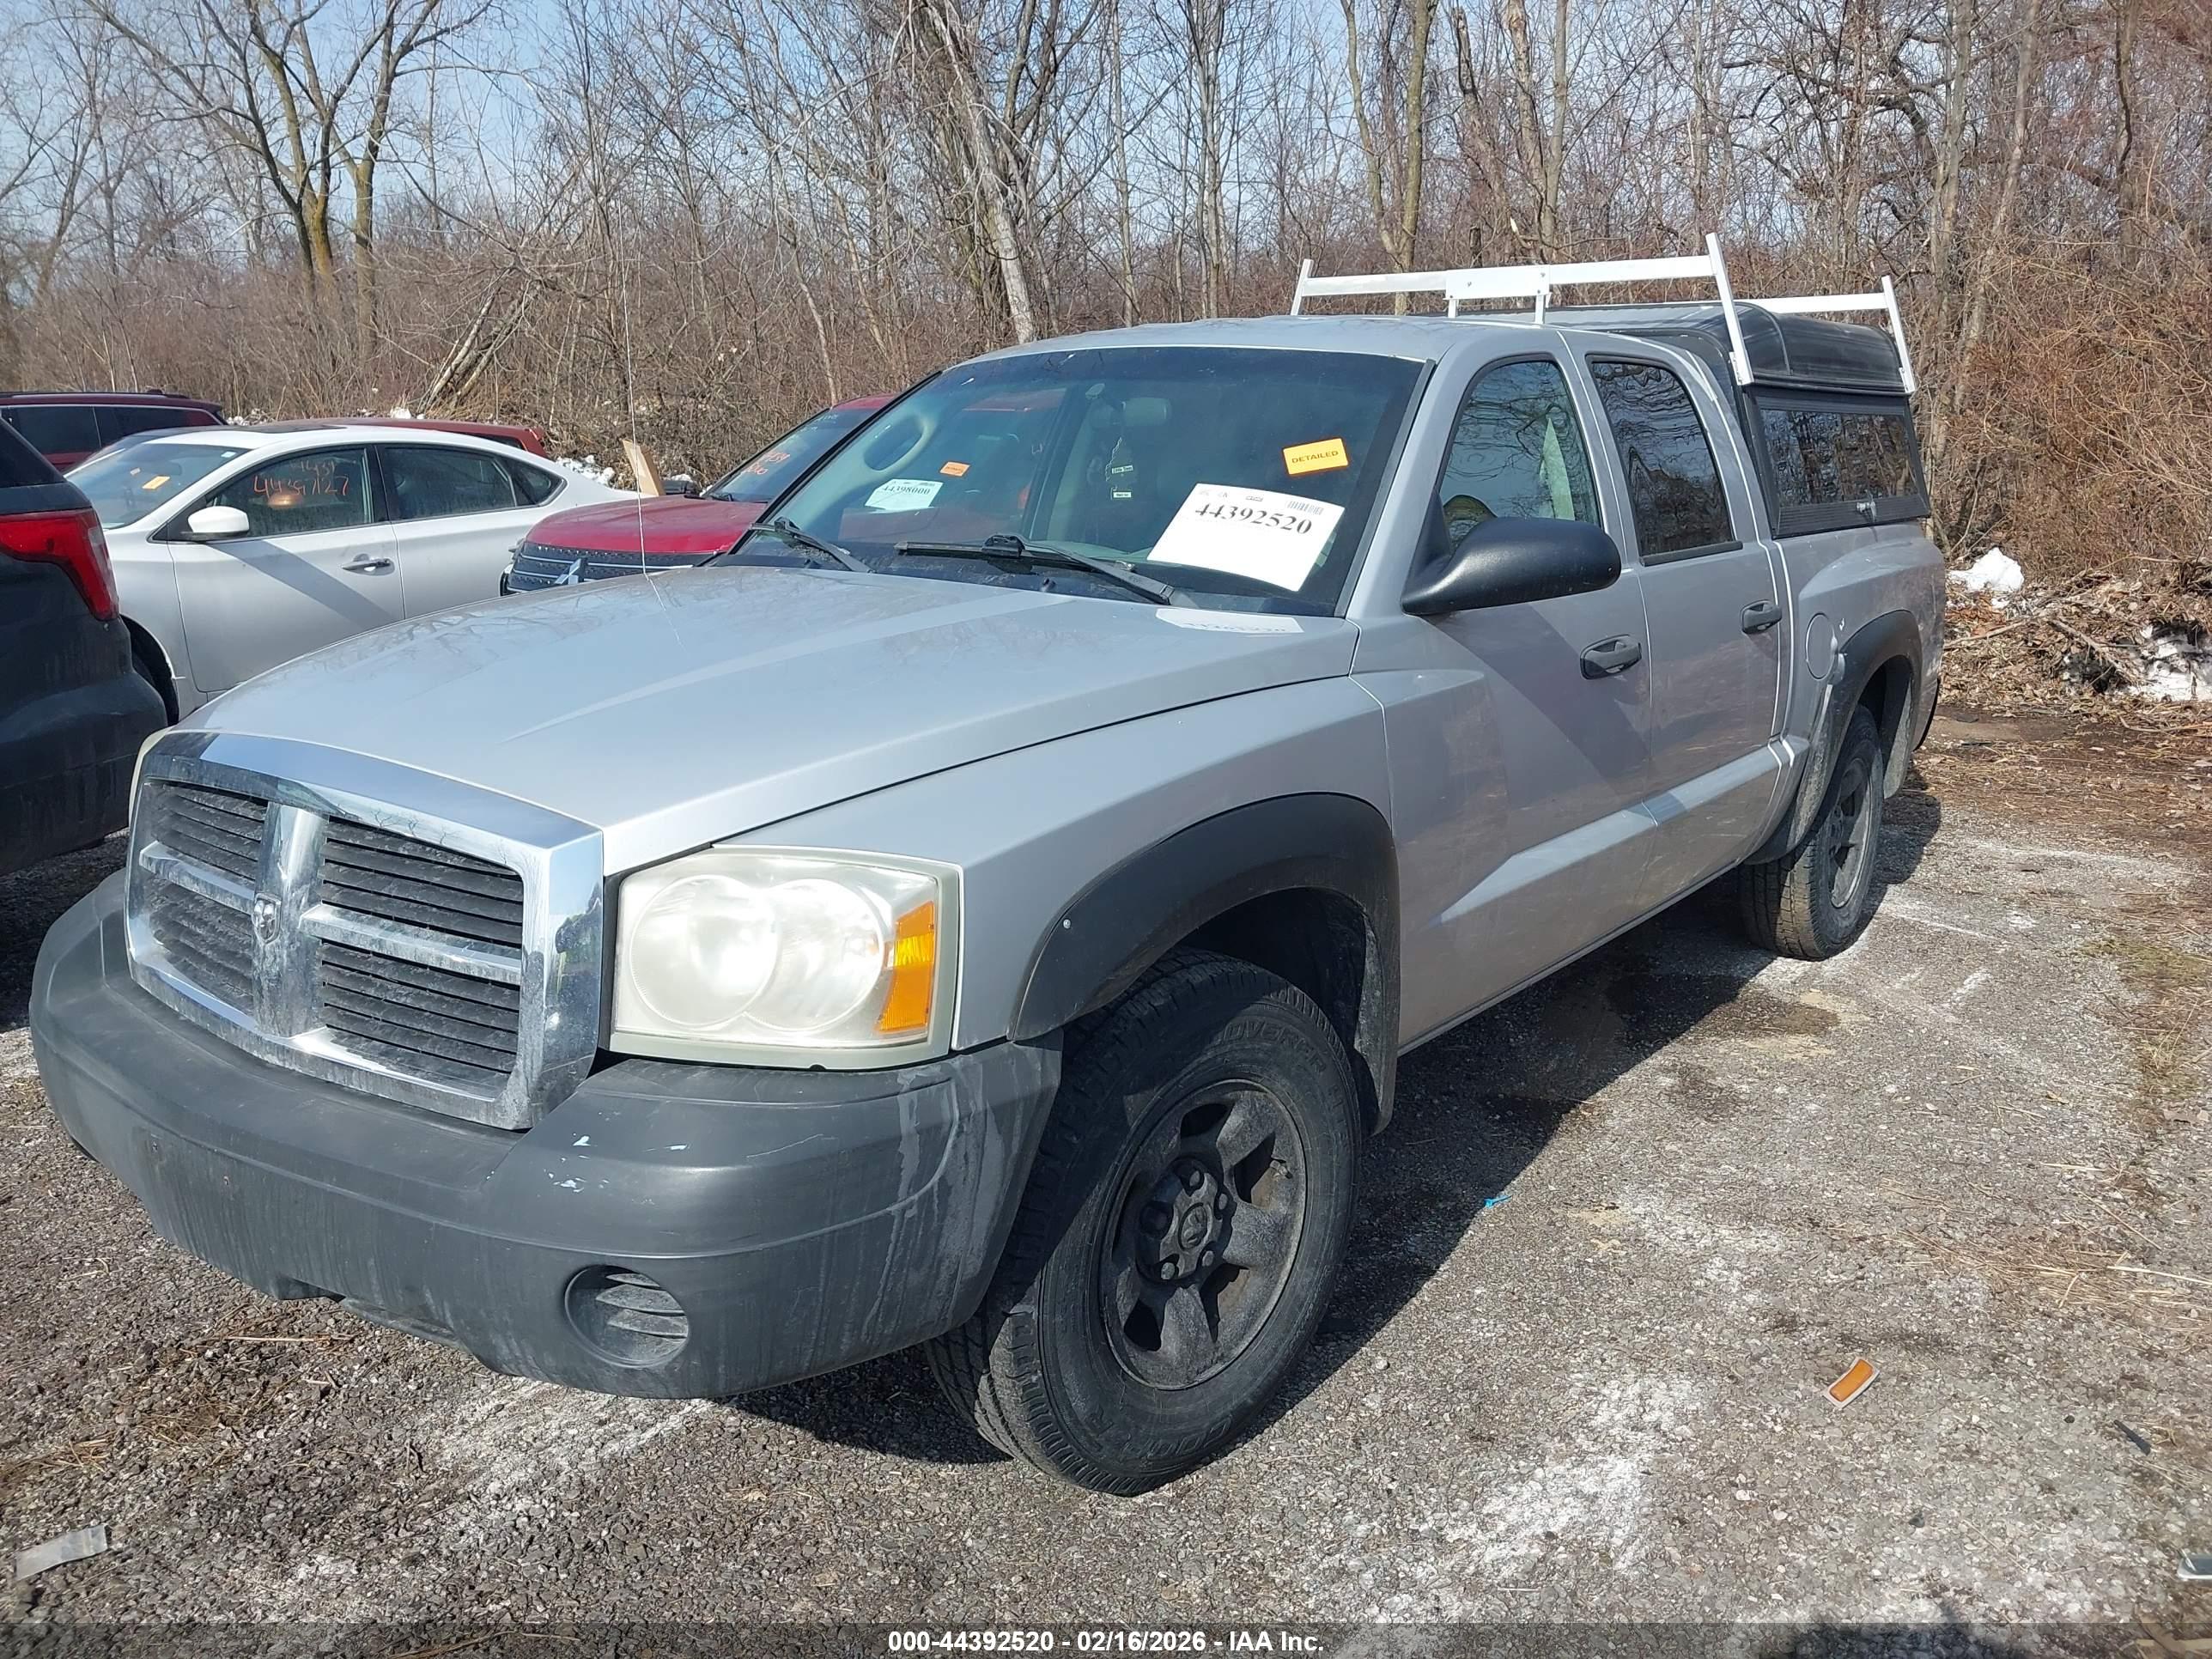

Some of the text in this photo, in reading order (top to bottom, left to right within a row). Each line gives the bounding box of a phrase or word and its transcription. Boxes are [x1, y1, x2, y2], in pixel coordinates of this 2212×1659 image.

[1291, 451, 1339, 464] DETAILED
[883, 485, 931, 495] 44398000
[1195, 503, 1312, 534] 44392520
